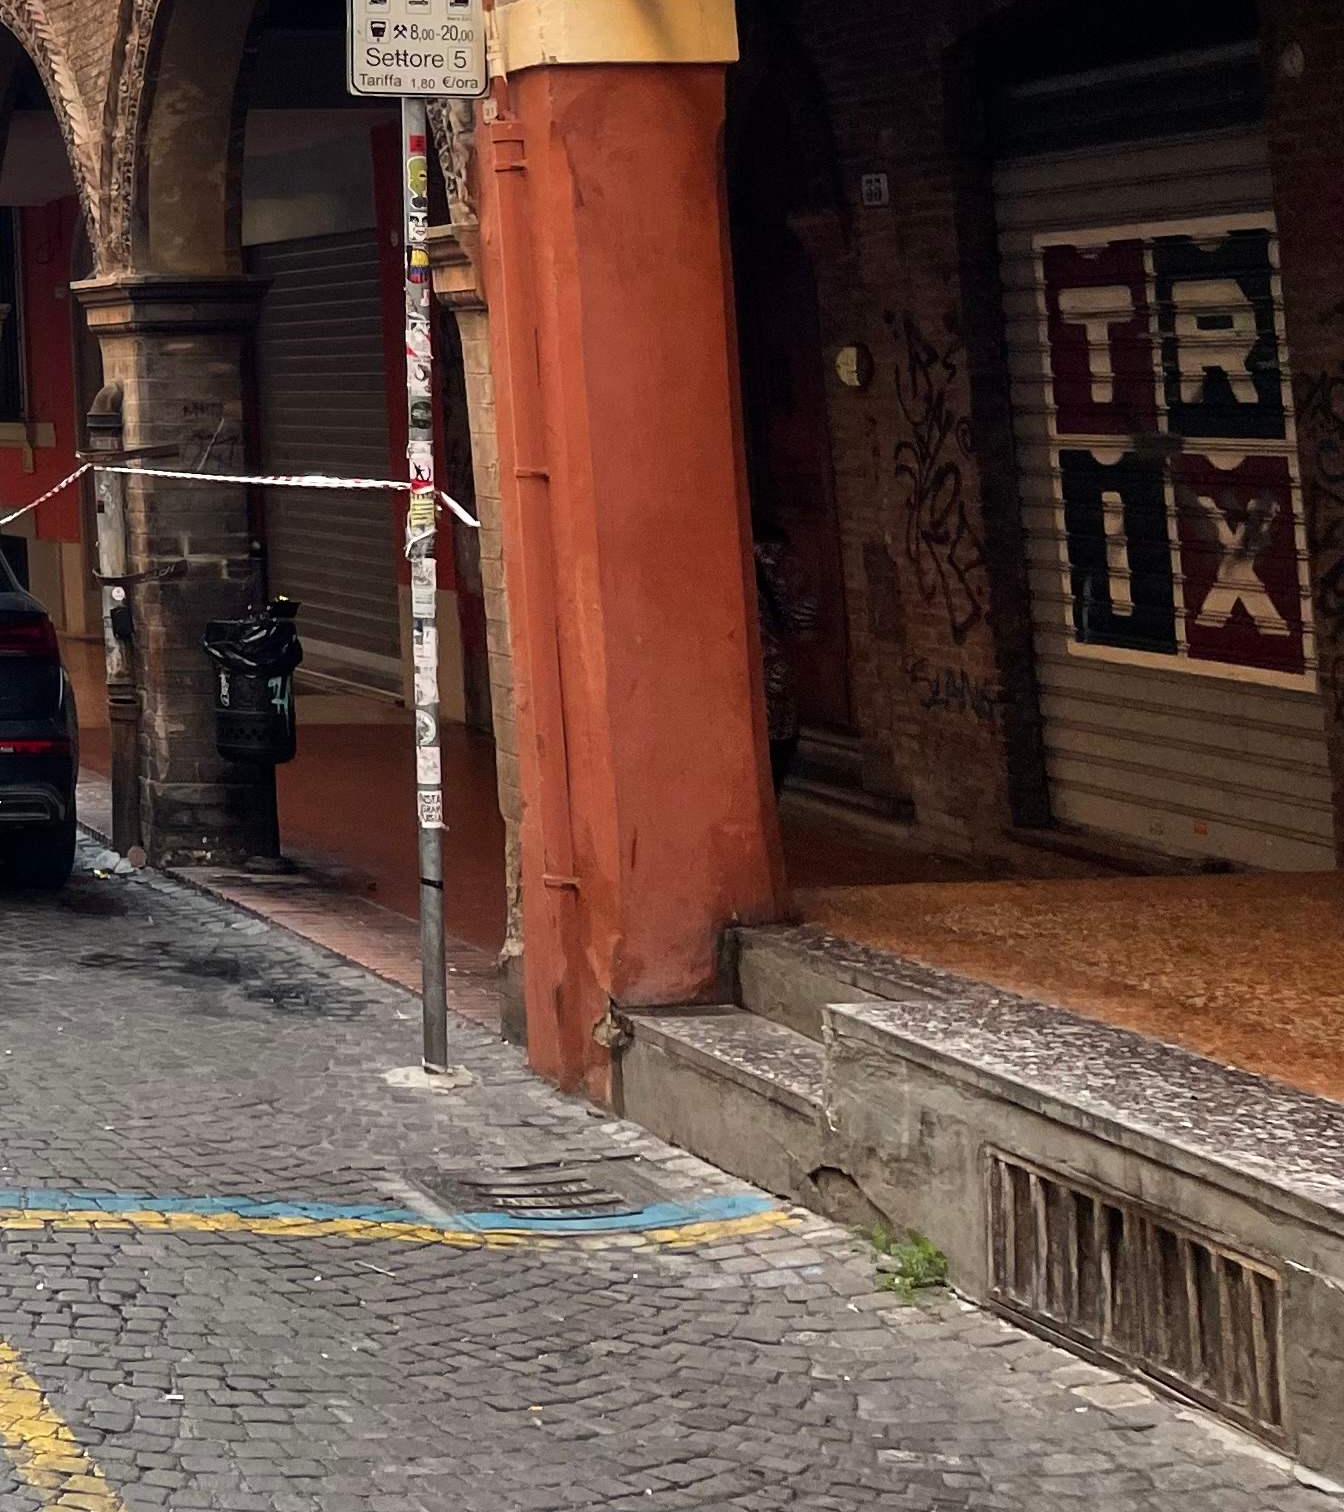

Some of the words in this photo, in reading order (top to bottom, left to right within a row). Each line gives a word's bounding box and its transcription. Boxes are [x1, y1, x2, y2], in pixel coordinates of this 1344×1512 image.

[366, 47, 444, 69] Settore
[453, 50, 467, 69] 5
[359, 74, 402, 88] Tariffa
